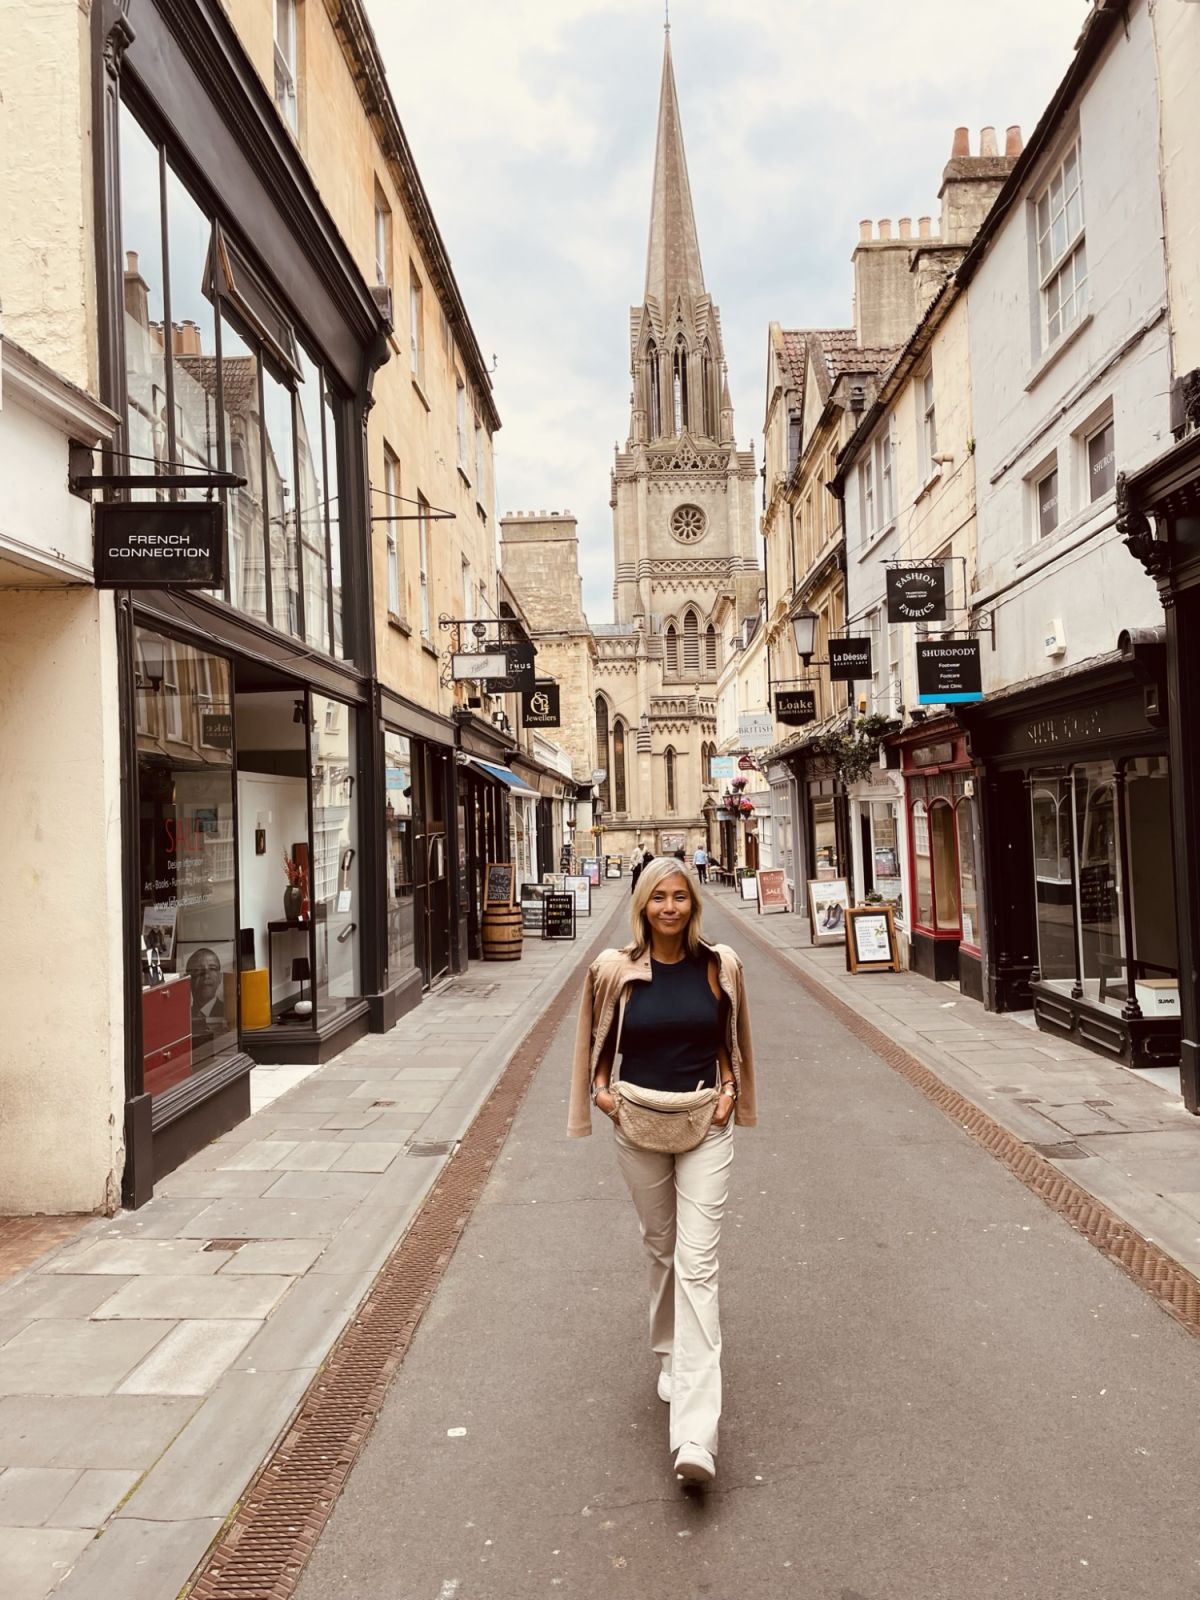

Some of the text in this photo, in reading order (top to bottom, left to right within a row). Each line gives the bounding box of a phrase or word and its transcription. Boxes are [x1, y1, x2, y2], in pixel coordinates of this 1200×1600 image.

[128, 535, 190, 545] FRENCH
[108, 548, 210, 558] CONNECTION
[895, 572, 937, 589] FASHION
[898, 602, 935, 617] FABRICS
[833, 653, 842, 662] La
[922, 648, 976, 657] SHUROPODY
[778, 698, 813, 710] Loake
[525, 714, 557, 722] Jewellers
[738, 726, 773, 734] BRITISH
[164, 816, 205, 854] SALE
